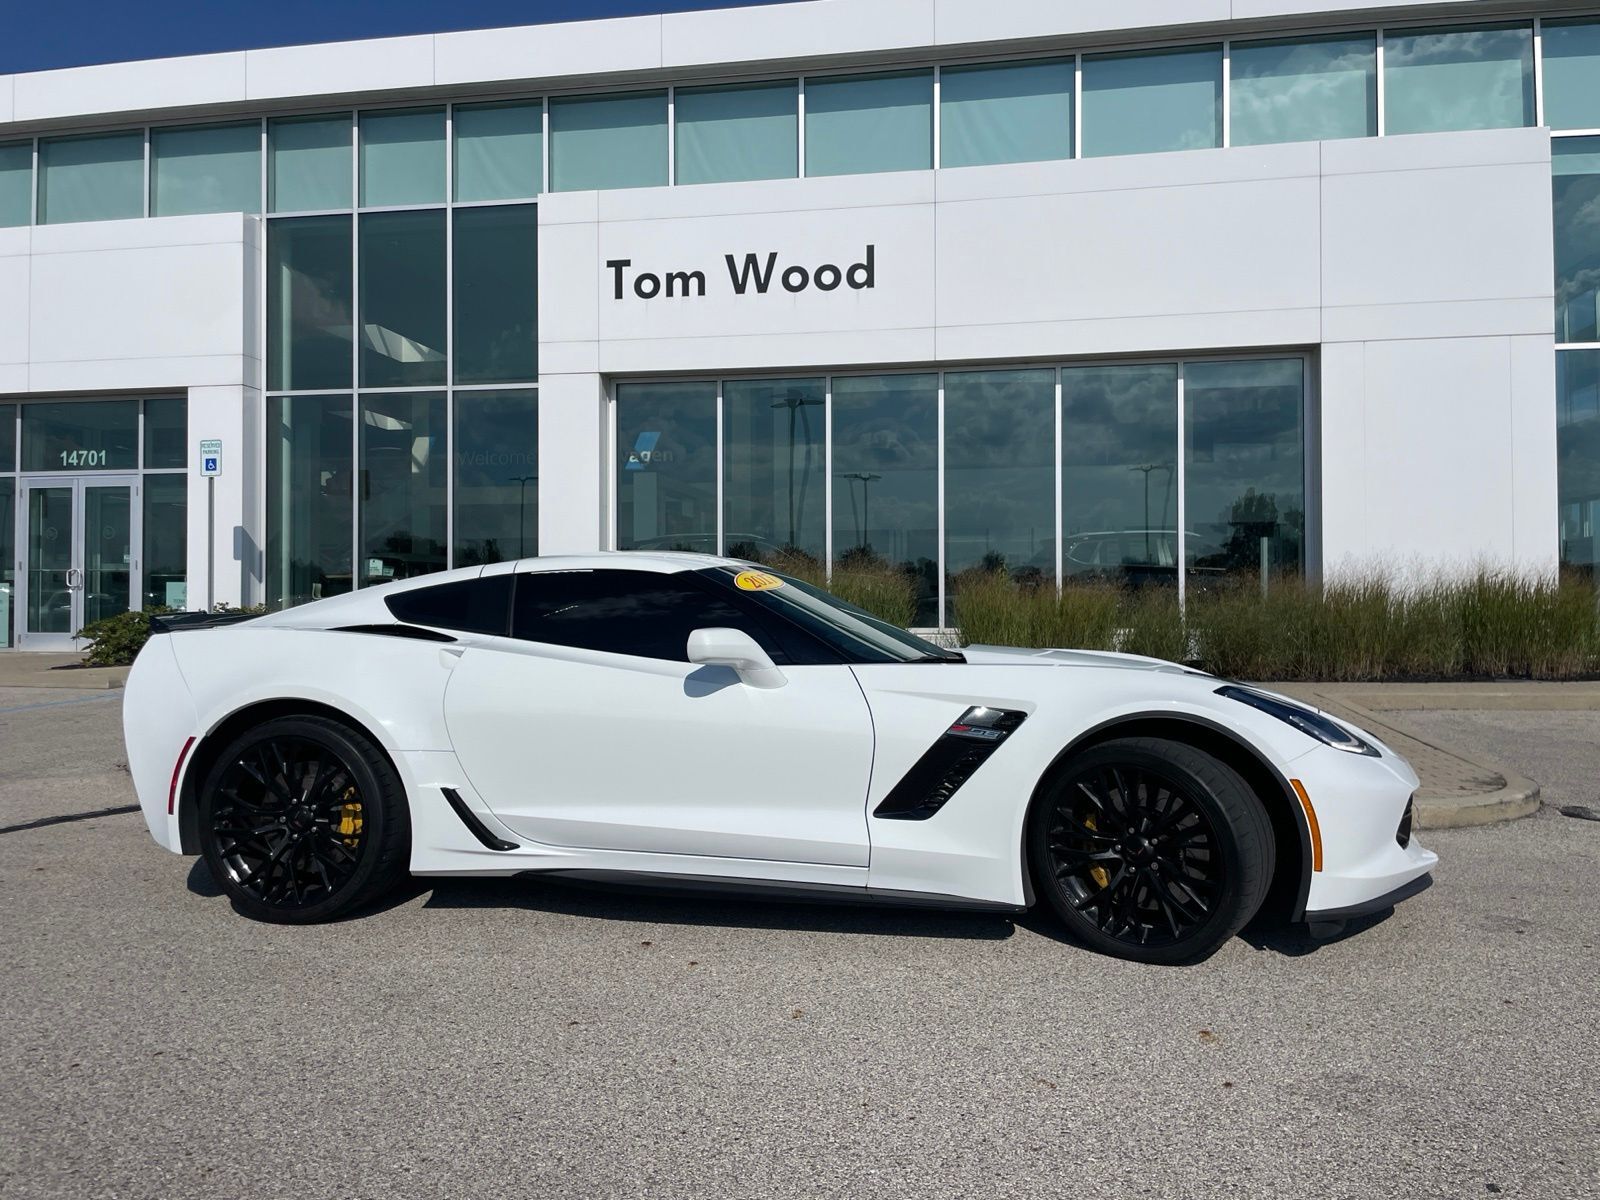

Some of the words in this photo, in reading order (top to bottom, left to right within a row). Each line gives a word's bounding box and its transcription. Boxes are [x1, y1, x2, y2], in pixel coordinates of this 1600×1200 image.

[606, 259, 706, 300] Tom
[724, 244, 875, 295] Wood
[60, 450, 106, 467] 14701
[457, 449, 535, 465] Welcome
